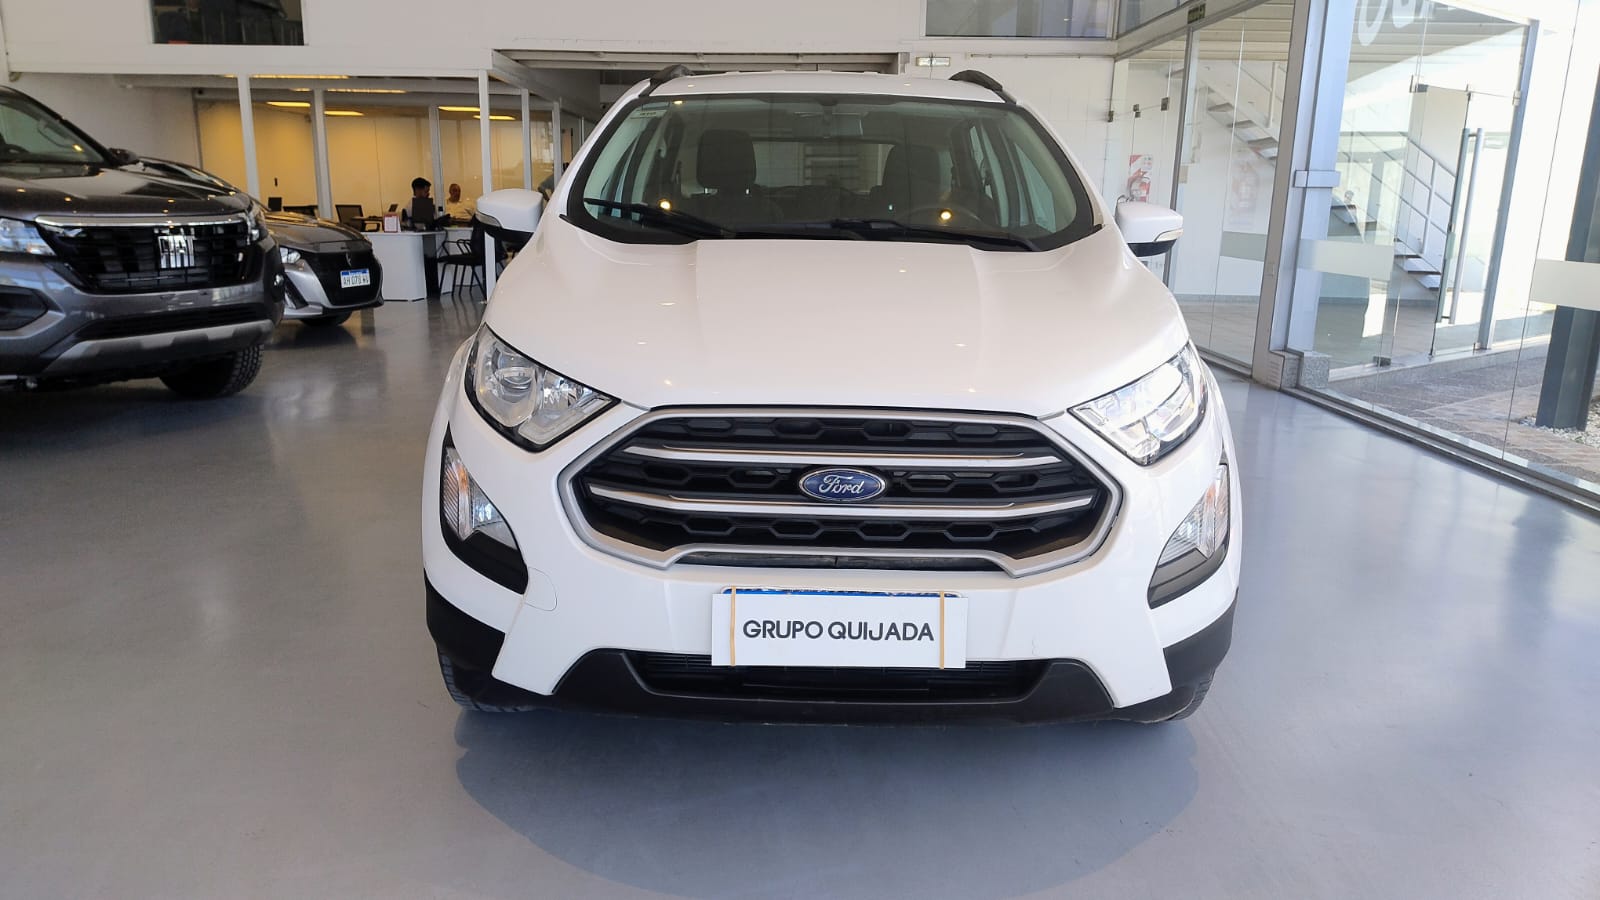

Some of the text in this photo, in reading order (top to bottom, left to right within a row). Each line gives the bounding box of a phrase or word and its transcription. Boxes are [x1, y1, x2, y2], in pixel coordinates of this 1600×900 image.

[819, 474, 865, 494] Ford
[743, 619, 934, 641] GRUPO QUIJADA
